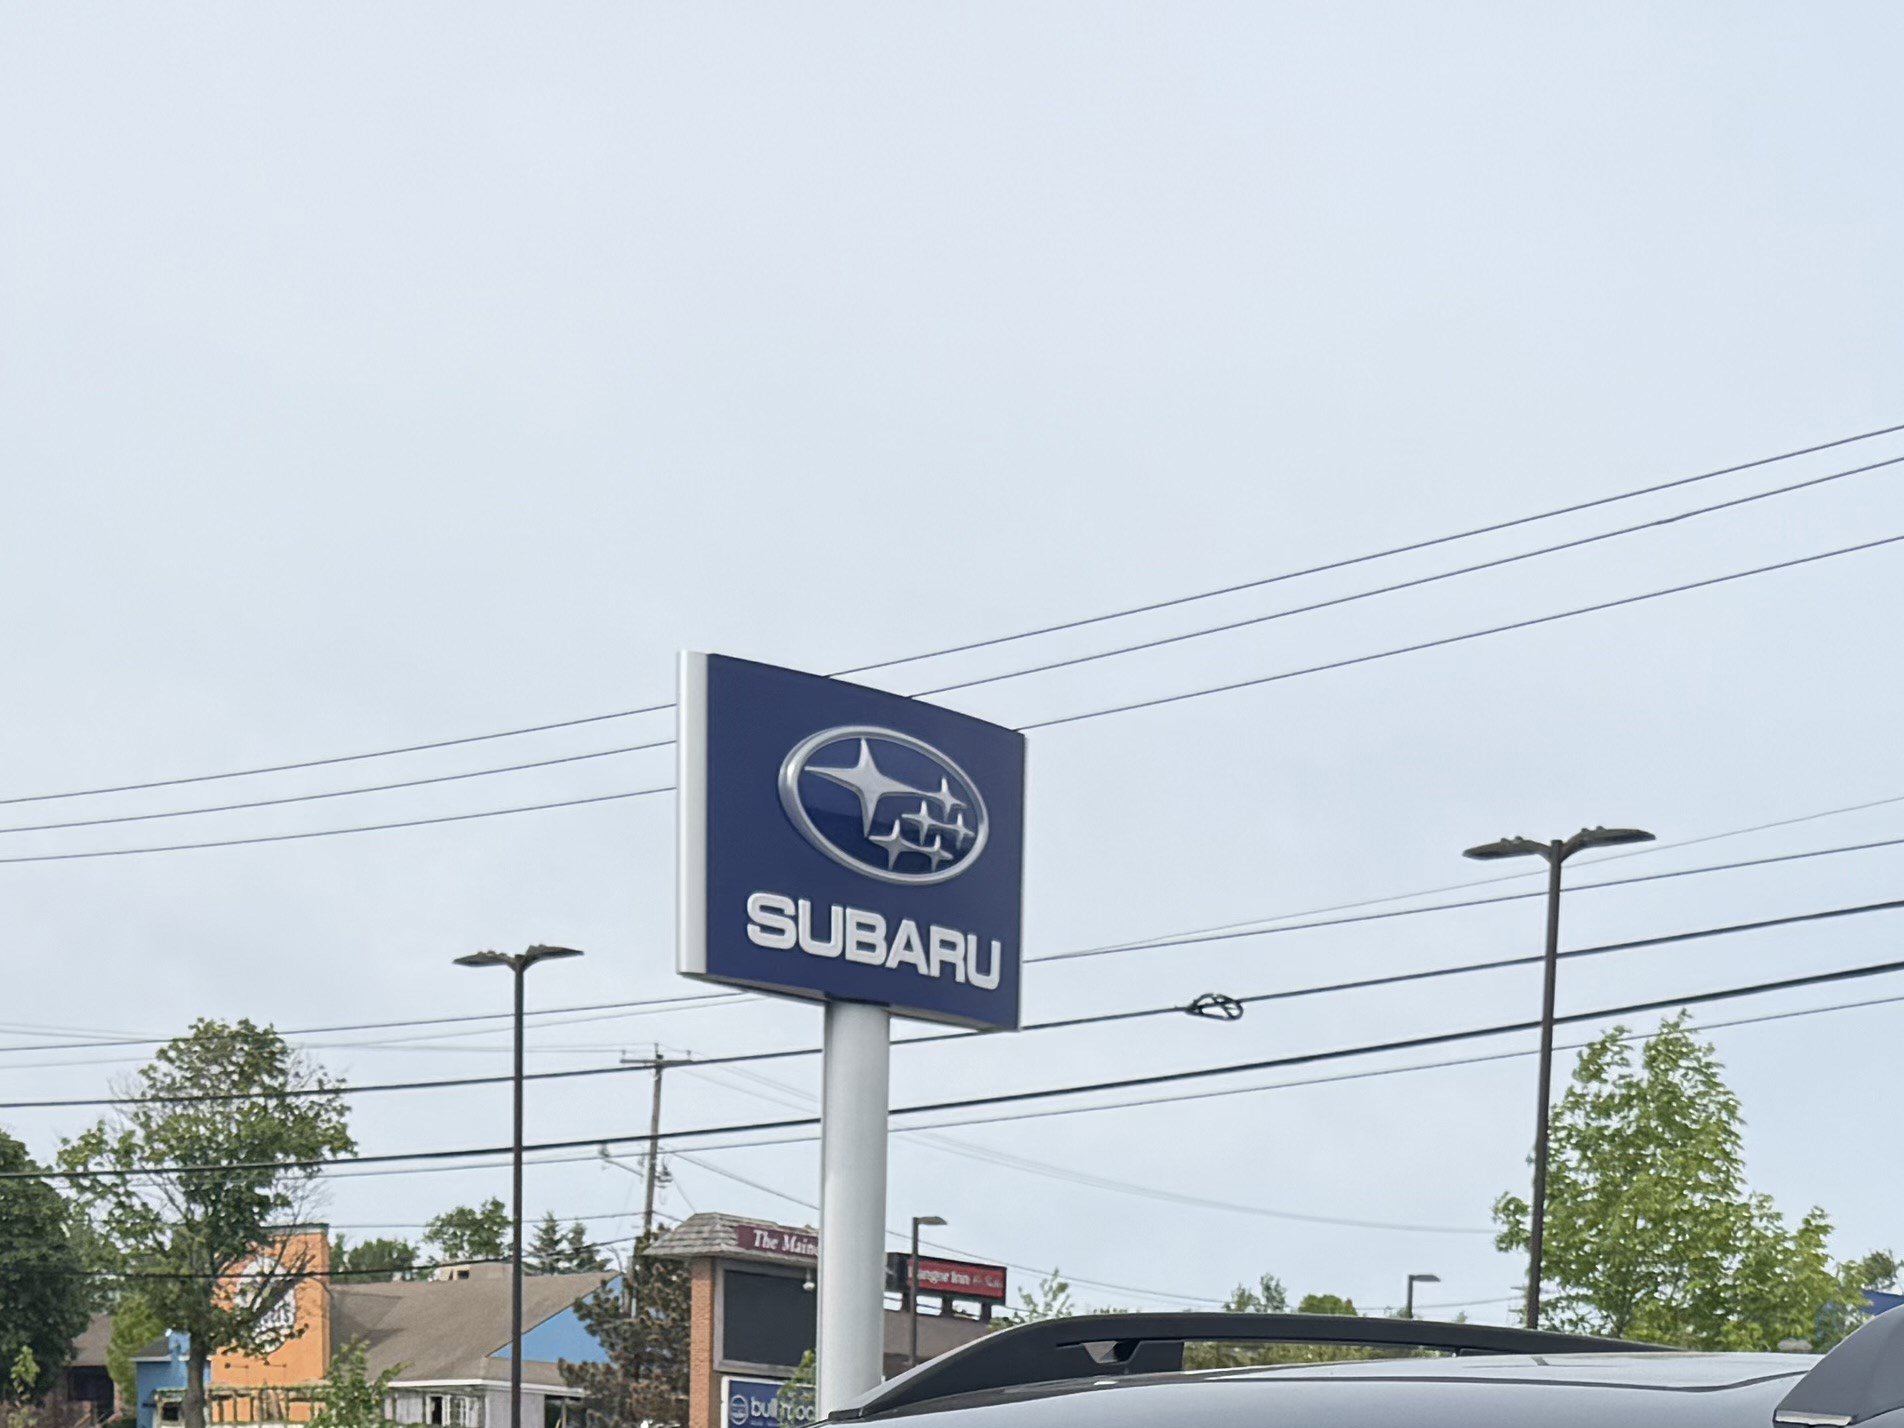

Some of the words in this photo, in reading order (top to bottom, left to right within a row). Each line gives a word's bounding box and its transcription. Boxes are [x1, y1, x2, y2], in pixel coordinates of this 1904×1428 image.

[747, 892, 1001, 990] SUBARU
[753, 1229, 778, 1250] The
[950, 1271, 970, 1285] Inn
